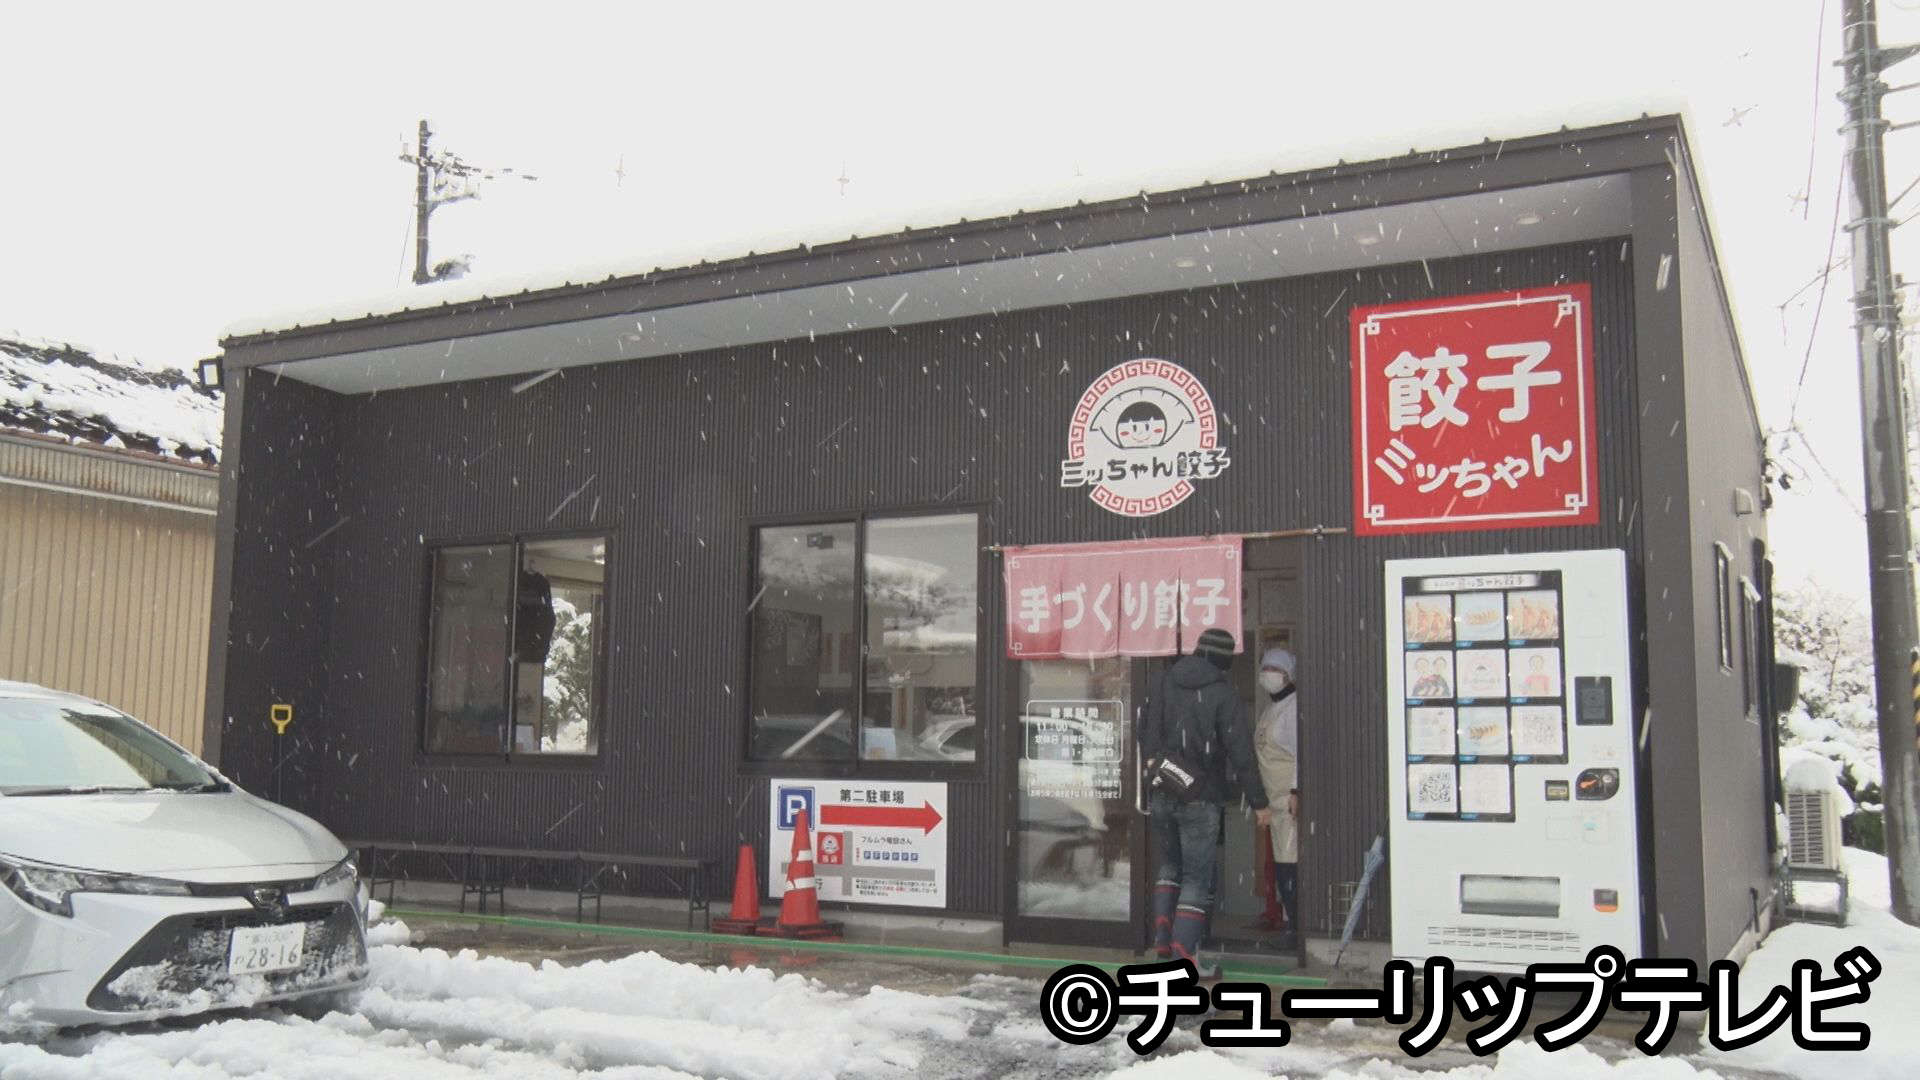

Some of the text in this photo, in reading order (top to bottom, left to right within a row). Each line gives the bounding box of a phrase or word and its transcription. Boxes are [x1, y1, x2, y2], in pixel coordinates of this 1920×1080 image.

[1383, 340, 1562, 432] 餃子
[1062, 450, 1229, 485] ミッちゃん餃子
[1374, 433, 1573, 498] ミッちゃん
[1017, 578, 1231, 633] 手づくり餃子
[786, 795, 807, 824] P
[840, 789, 905, 804] 第二駐車場
